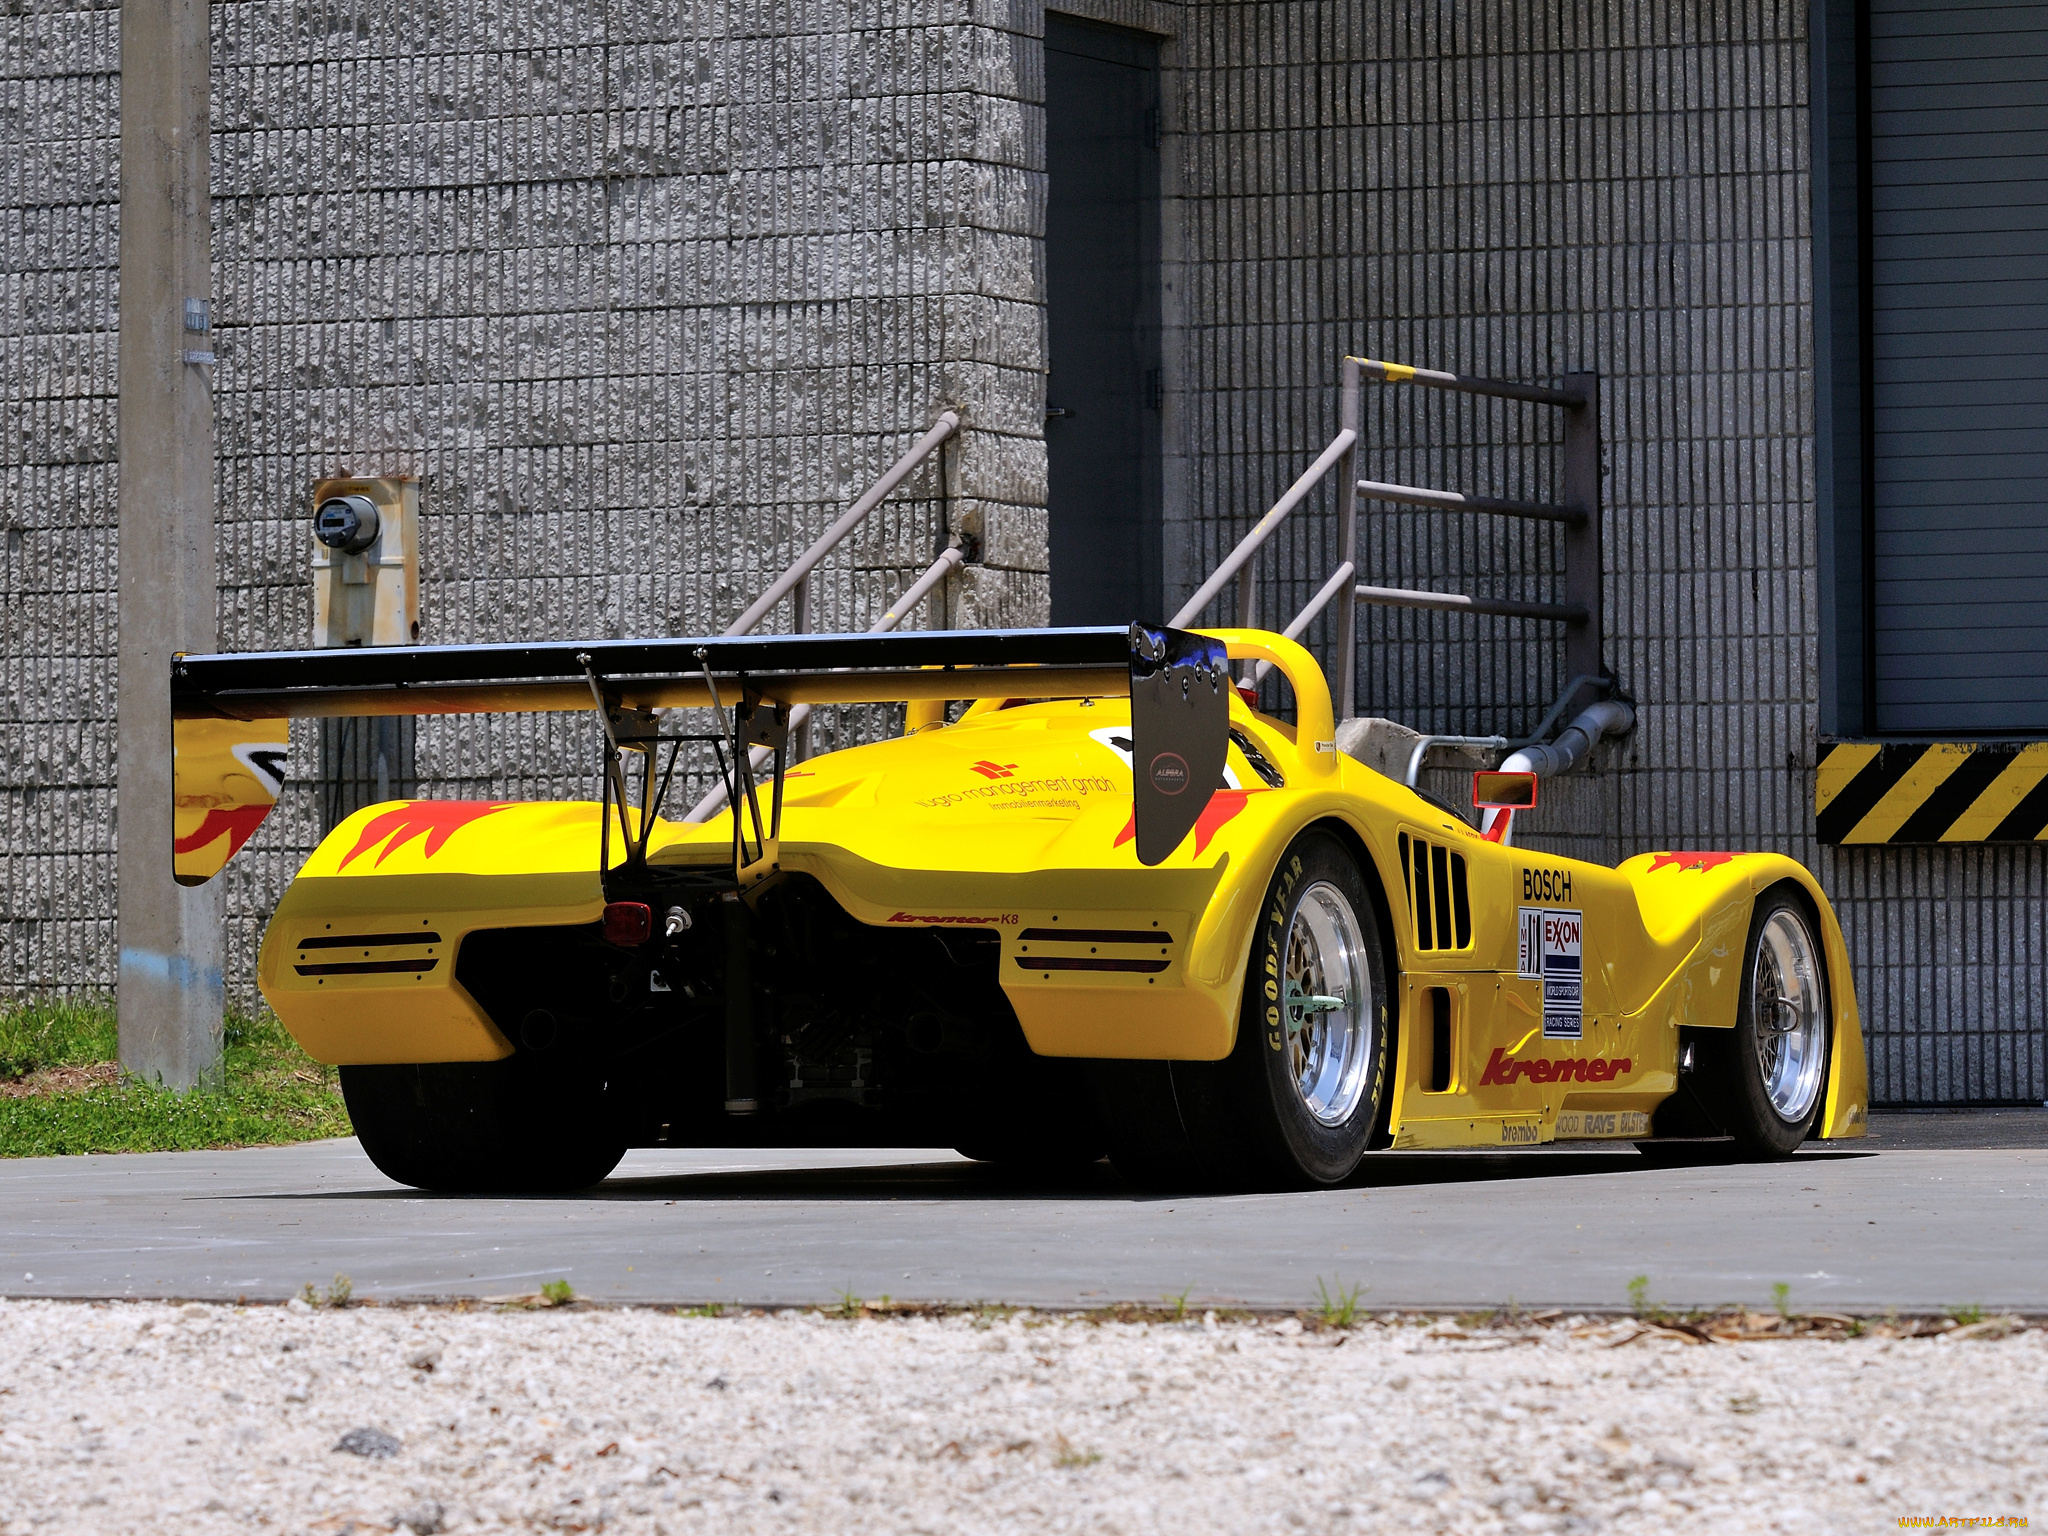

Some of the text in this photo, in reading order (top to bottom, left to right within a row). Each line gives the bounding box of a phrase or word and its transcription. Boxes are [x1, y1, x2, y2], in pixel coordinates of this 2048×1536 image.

[961, 776, 1071, 799] management
[1072, 775, 1118, 796] gmbh
[989, 798, 1081, 810] Immobilienmarketing
[1523, 868, 1572, 902] BOSCH
[887, 912, 1019, 925] kremer K8
[1520, 913, 1528, 973] IMSA
[1545, 917, 1580, 953] EXXON
[1546, 1017, 1580, 1028] RACING SERIES
[1479, 1047, 1632, 1086] kremer
[1501, 1120, 1538, 1142] brembo
[1584, 1114, 1616, 1134] RAYS
